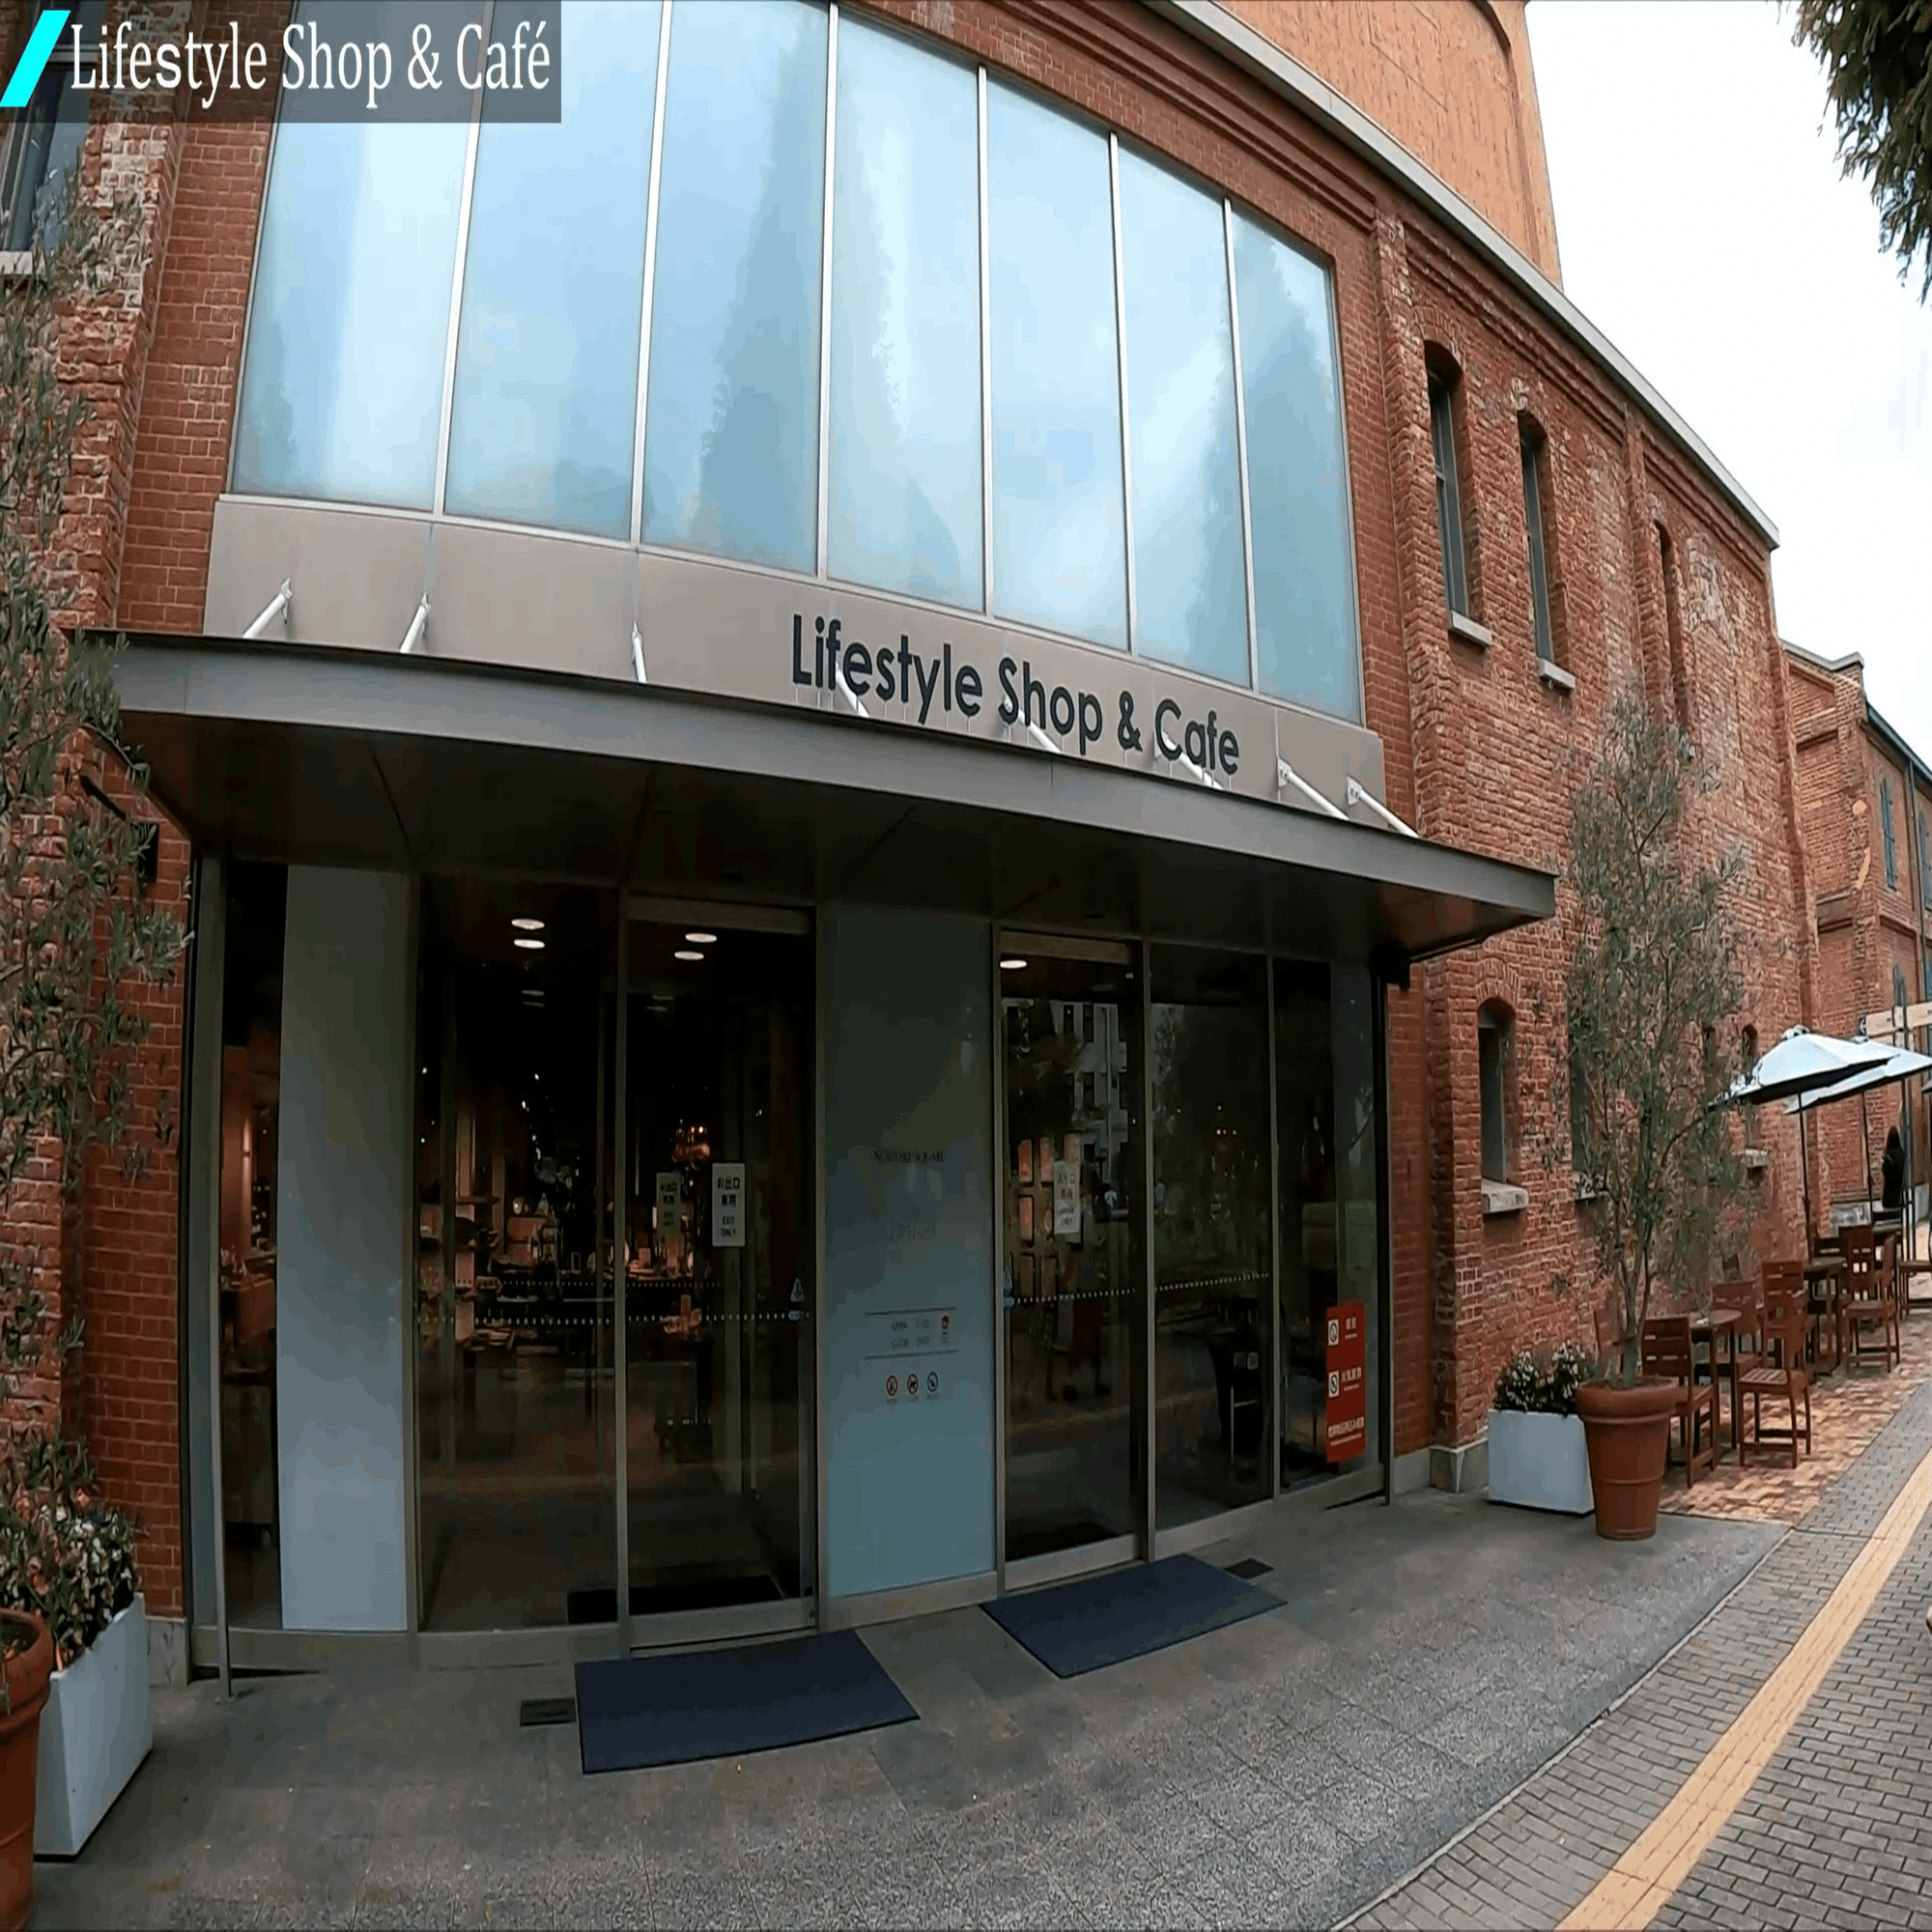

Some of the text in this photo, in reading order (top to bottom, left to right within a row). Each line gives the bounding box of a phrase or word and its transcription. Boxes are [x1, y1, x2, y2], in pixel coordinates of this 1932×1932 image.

[791, 613, 1240, 776] Lifestyle Shop & Cafe
